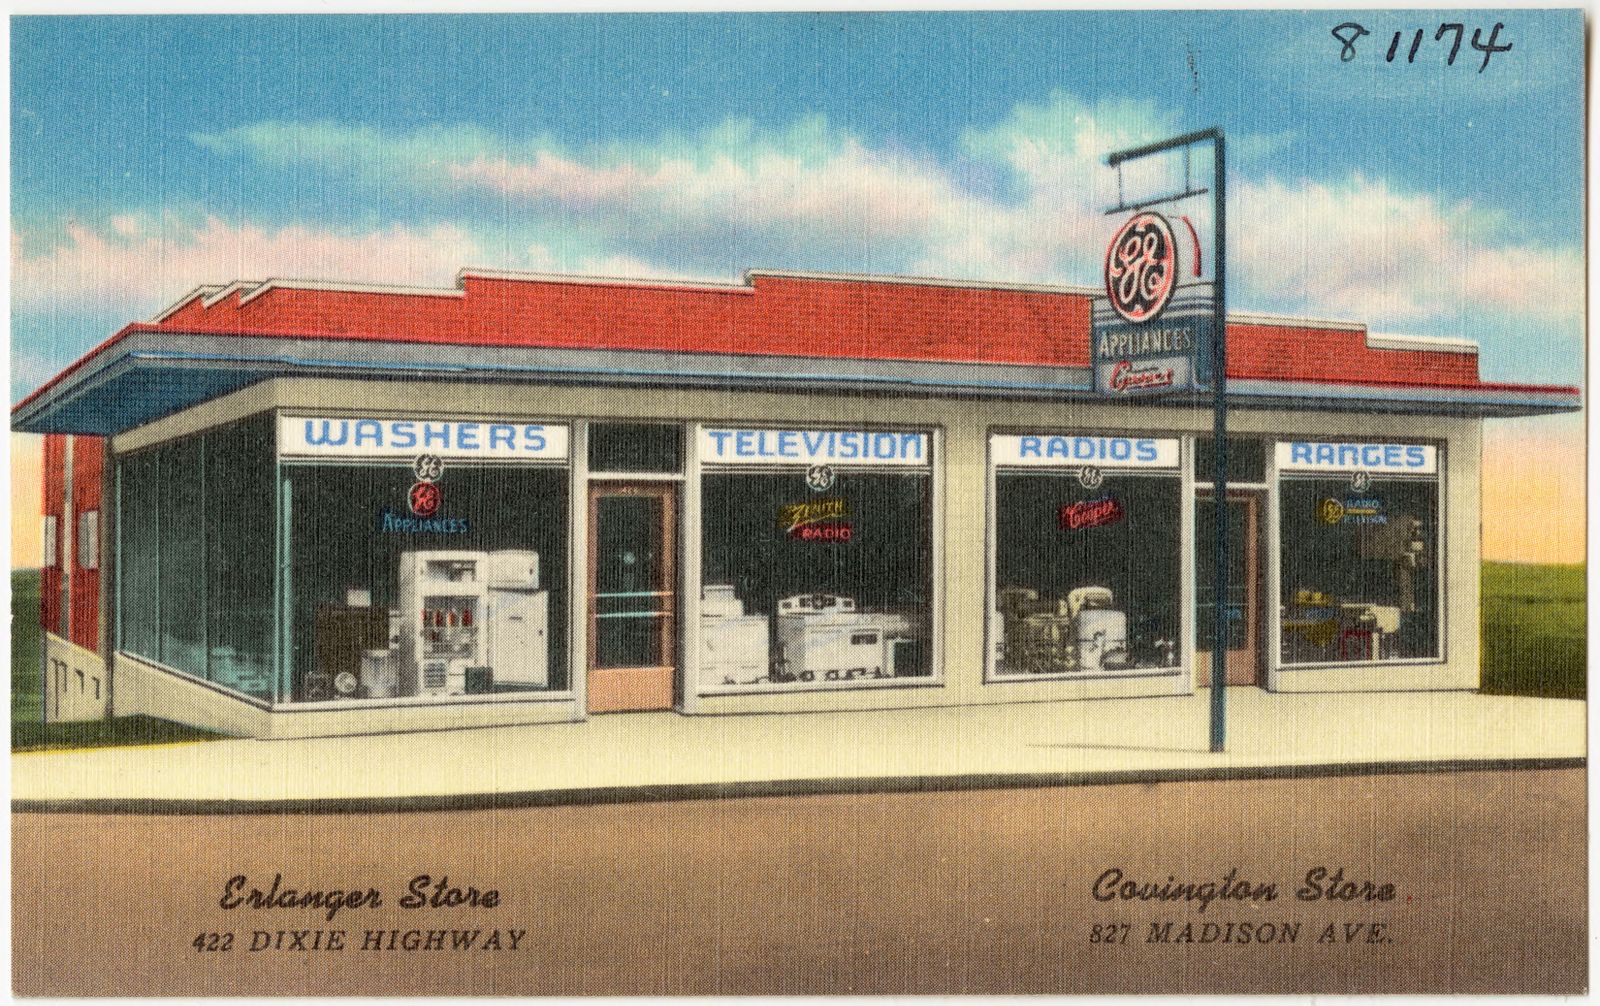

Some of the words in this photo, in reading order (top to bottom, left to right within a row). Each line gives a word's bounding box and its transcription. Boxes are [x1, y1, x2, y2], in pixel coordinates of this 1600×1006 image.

[1331, 22, 1370, 62] 8
[1386, 22, 1513, 73] 1174
[1099, 327, 1191, 356] APPLIANCES
[304, 419, 547, 451] WASHERS
[708, 430, 923, 459] TELEVISION
[1020, 436, 1158, 461] RADIOS
[1291, 443, 1426, 467] RANGES
[802, 528, 851, 539] RADIO
